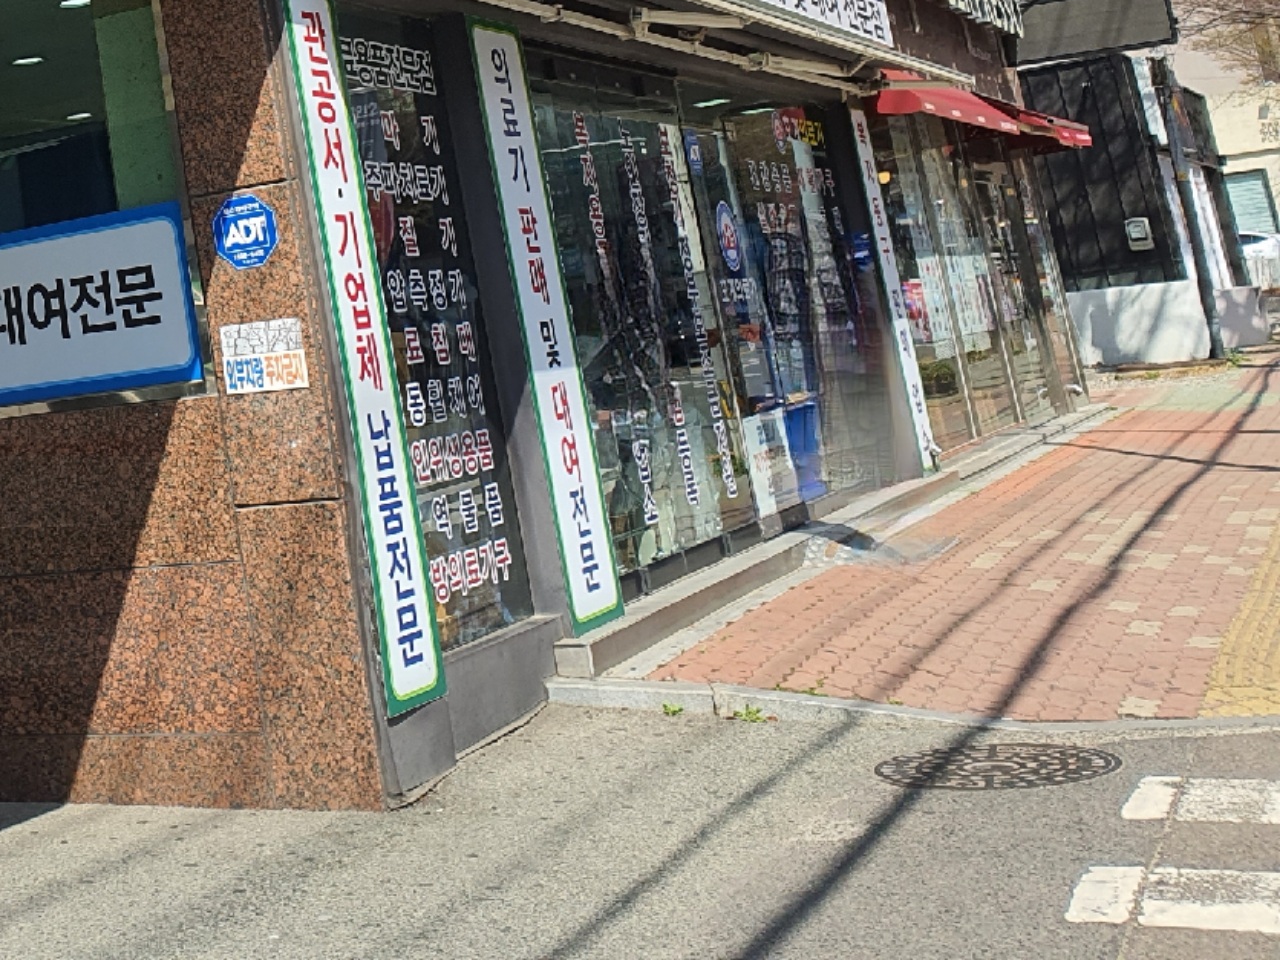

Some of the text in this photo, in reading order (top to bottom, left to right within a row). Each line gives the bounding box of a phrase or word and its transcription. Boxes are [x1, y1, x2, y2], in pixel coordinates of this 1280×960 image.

[225, 216, 266, 249] ADT
[490, 48, 531, 193] 의료기
[517, 206, 552, 306] 판매
[539, 317, 563, 369] 및
